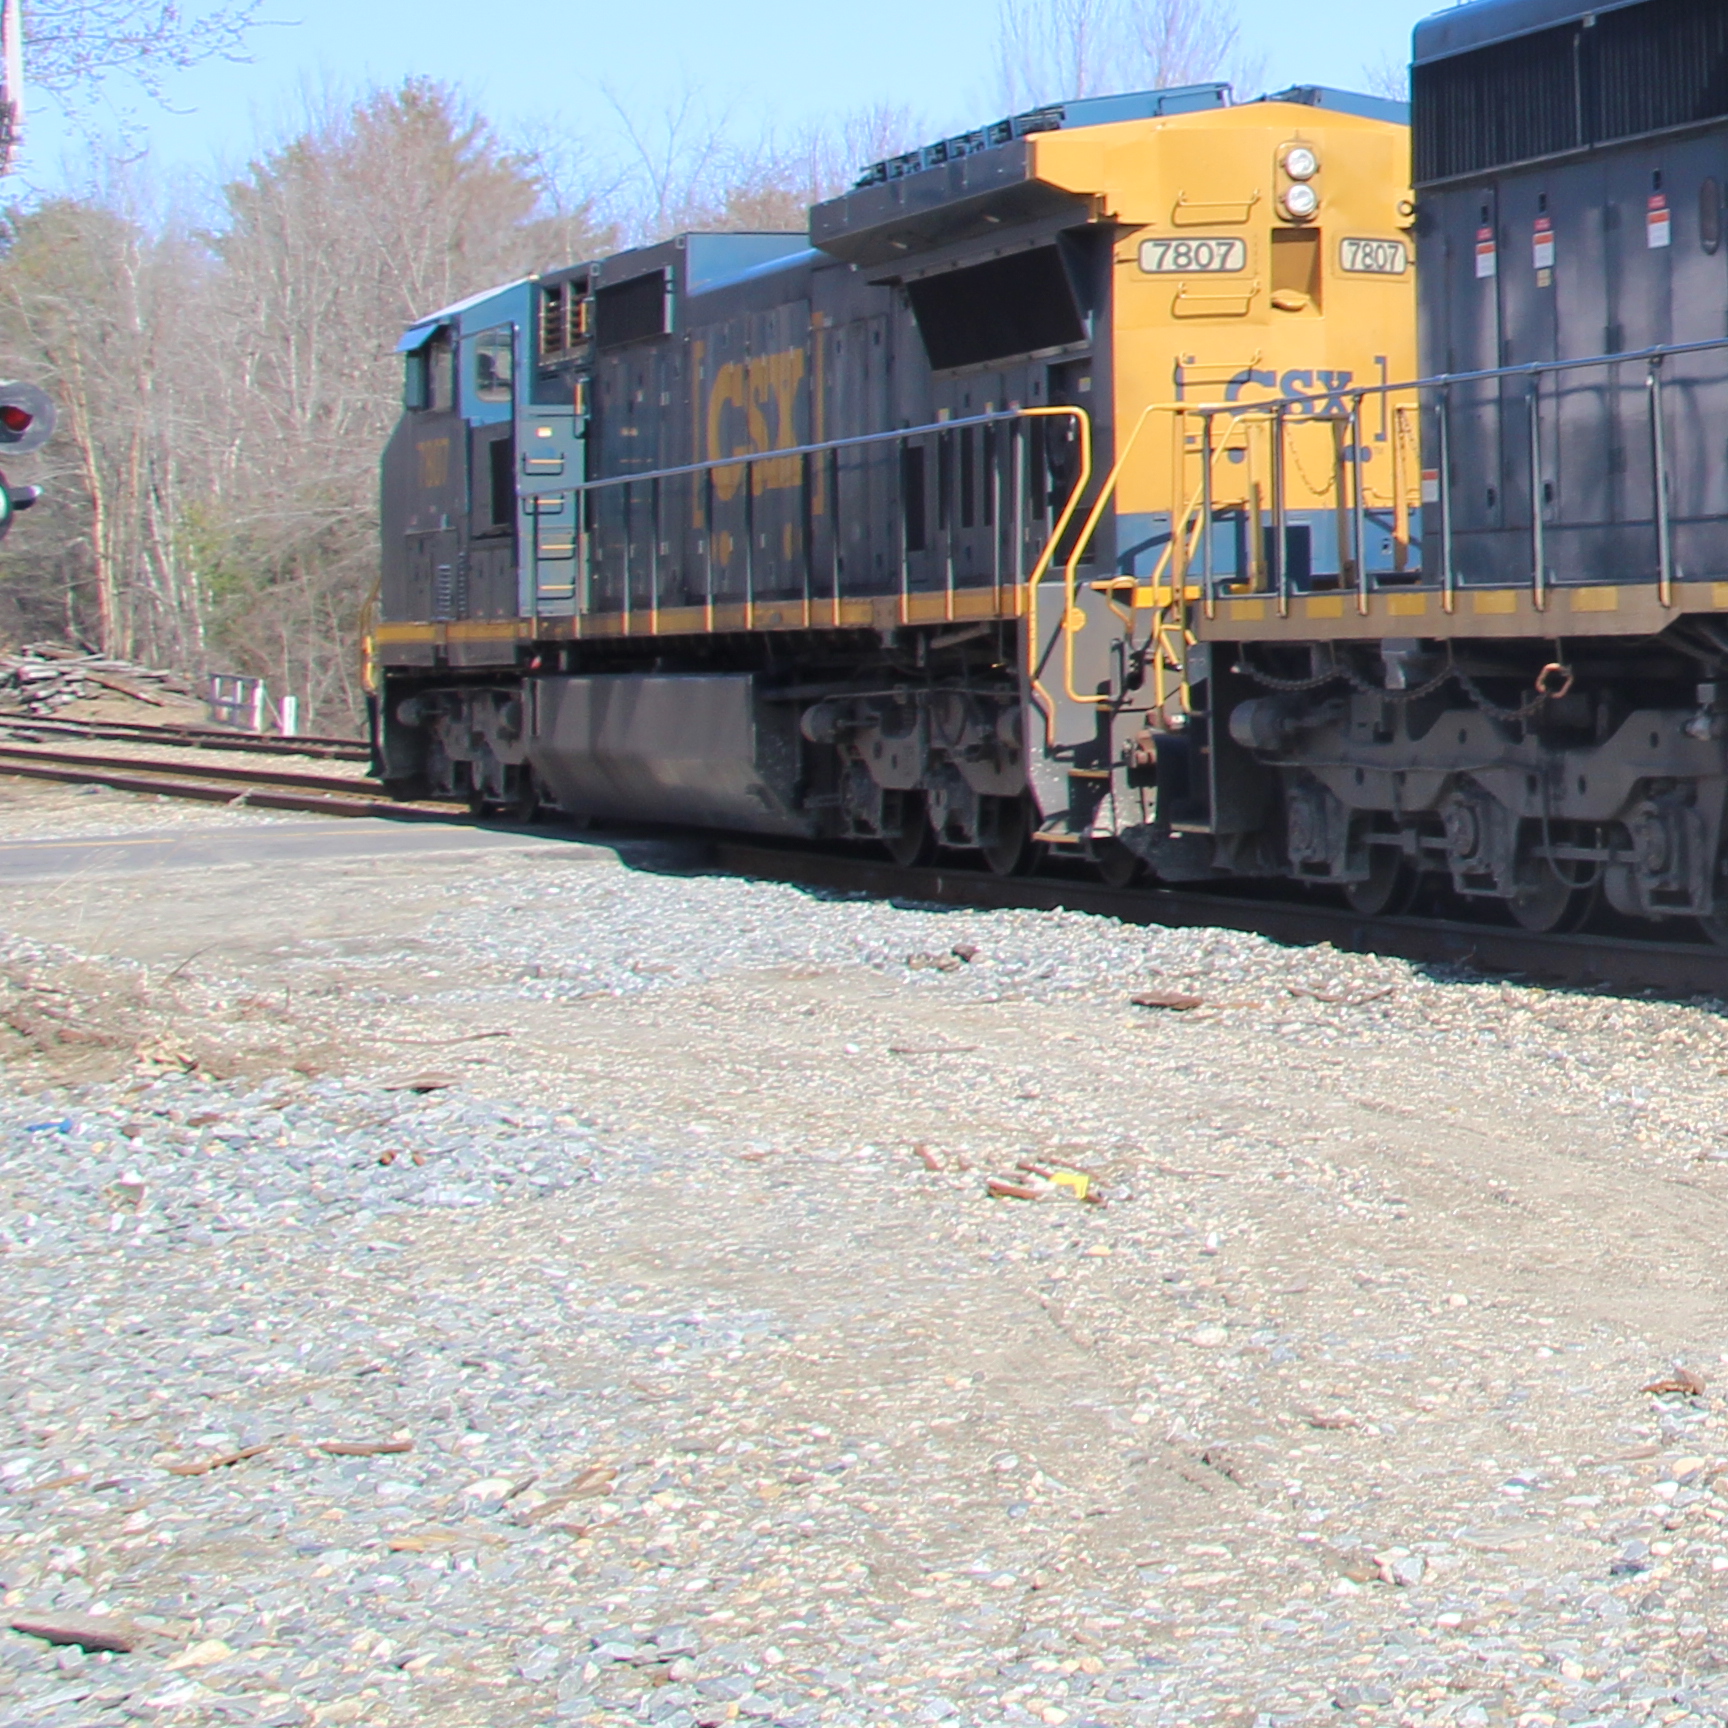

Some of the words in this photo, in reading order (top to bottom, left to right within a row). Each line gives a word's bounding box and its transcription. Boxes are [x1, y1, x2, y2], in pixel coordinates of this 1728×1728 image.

[1152, 240, 1236, 270] 7807
[1347, 240, 1400, 271] 7807
[1225, 369, 1354, 425] CSX
[707, 348, 804, 501] CSX
